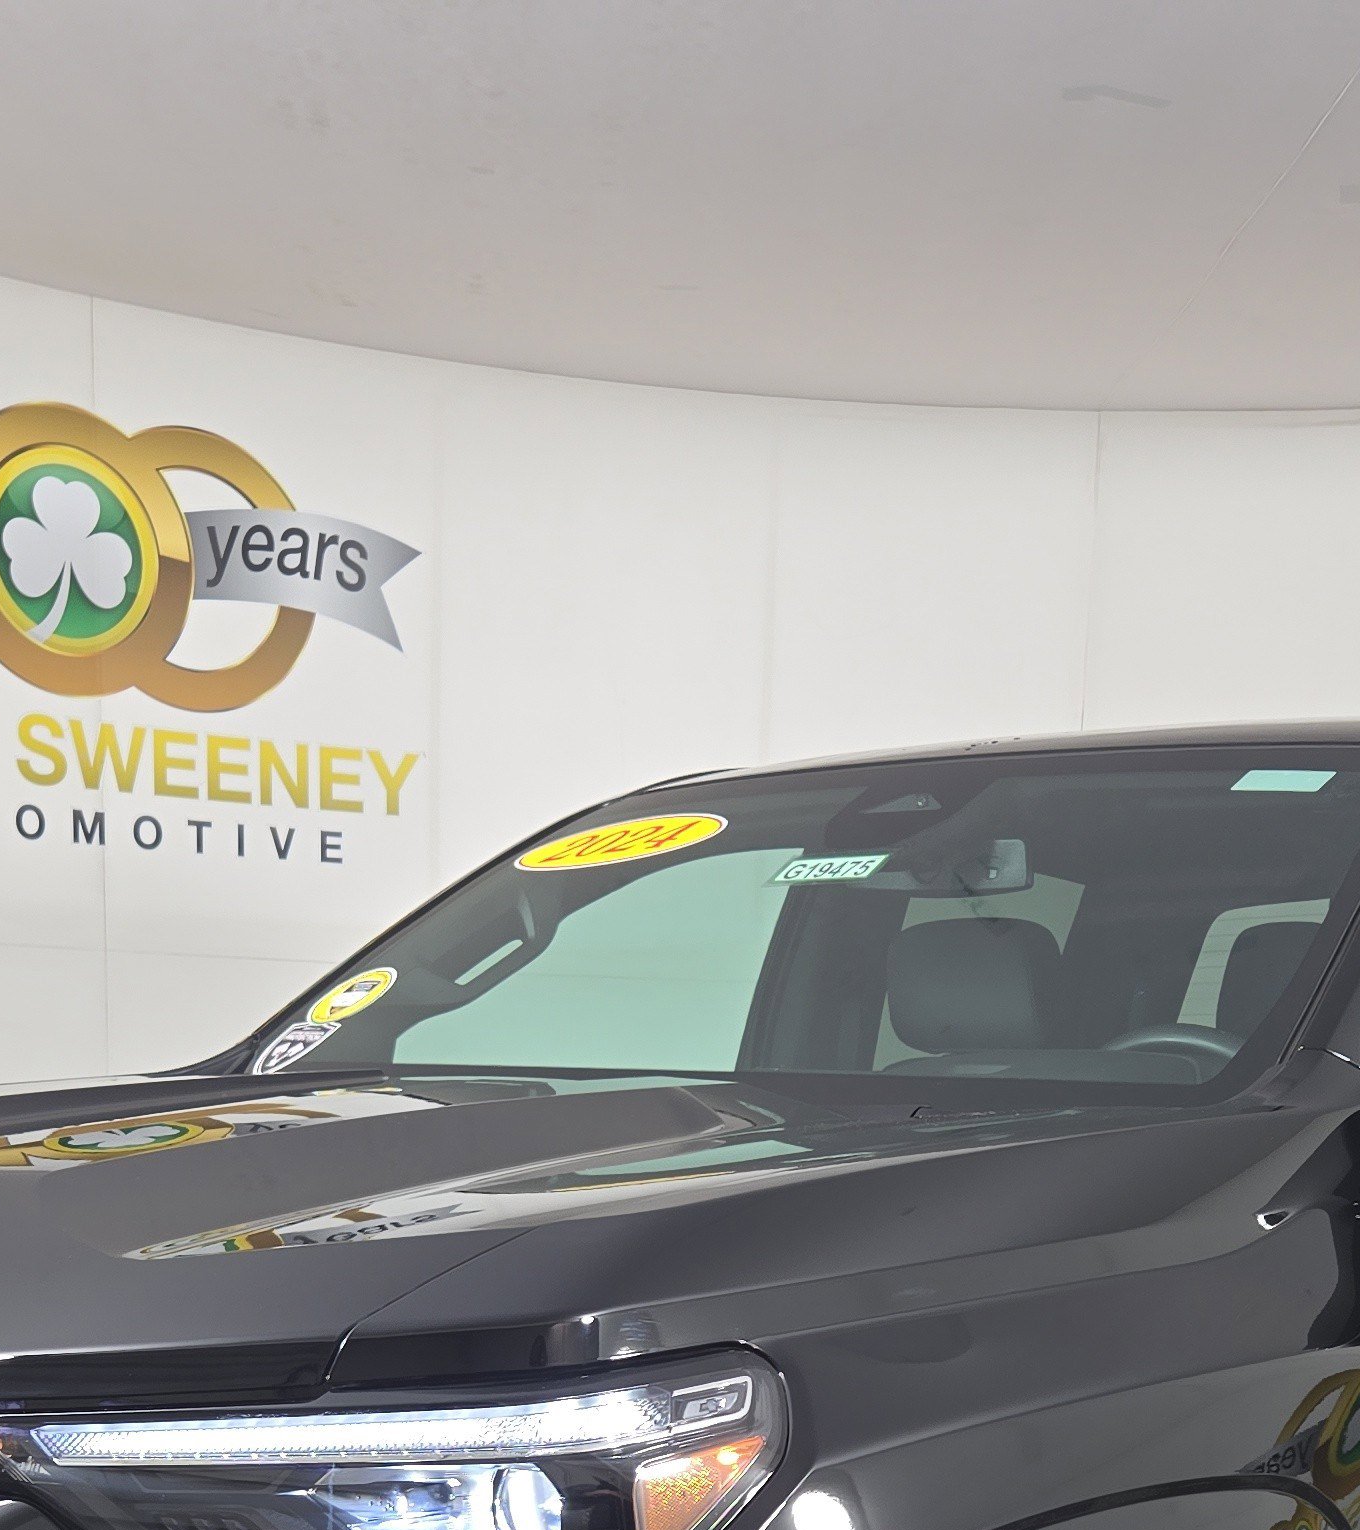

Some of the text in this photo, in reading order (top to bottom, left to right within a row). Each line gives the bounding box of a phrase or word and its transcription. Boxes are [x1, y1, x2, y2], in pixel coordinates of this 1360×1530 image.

[205, 523, 368, 592] years
[16, 711, 419, 816] SWEENEY
[539, 820, 703, 864] 2024
[783, 858, 878, 881] G19475
